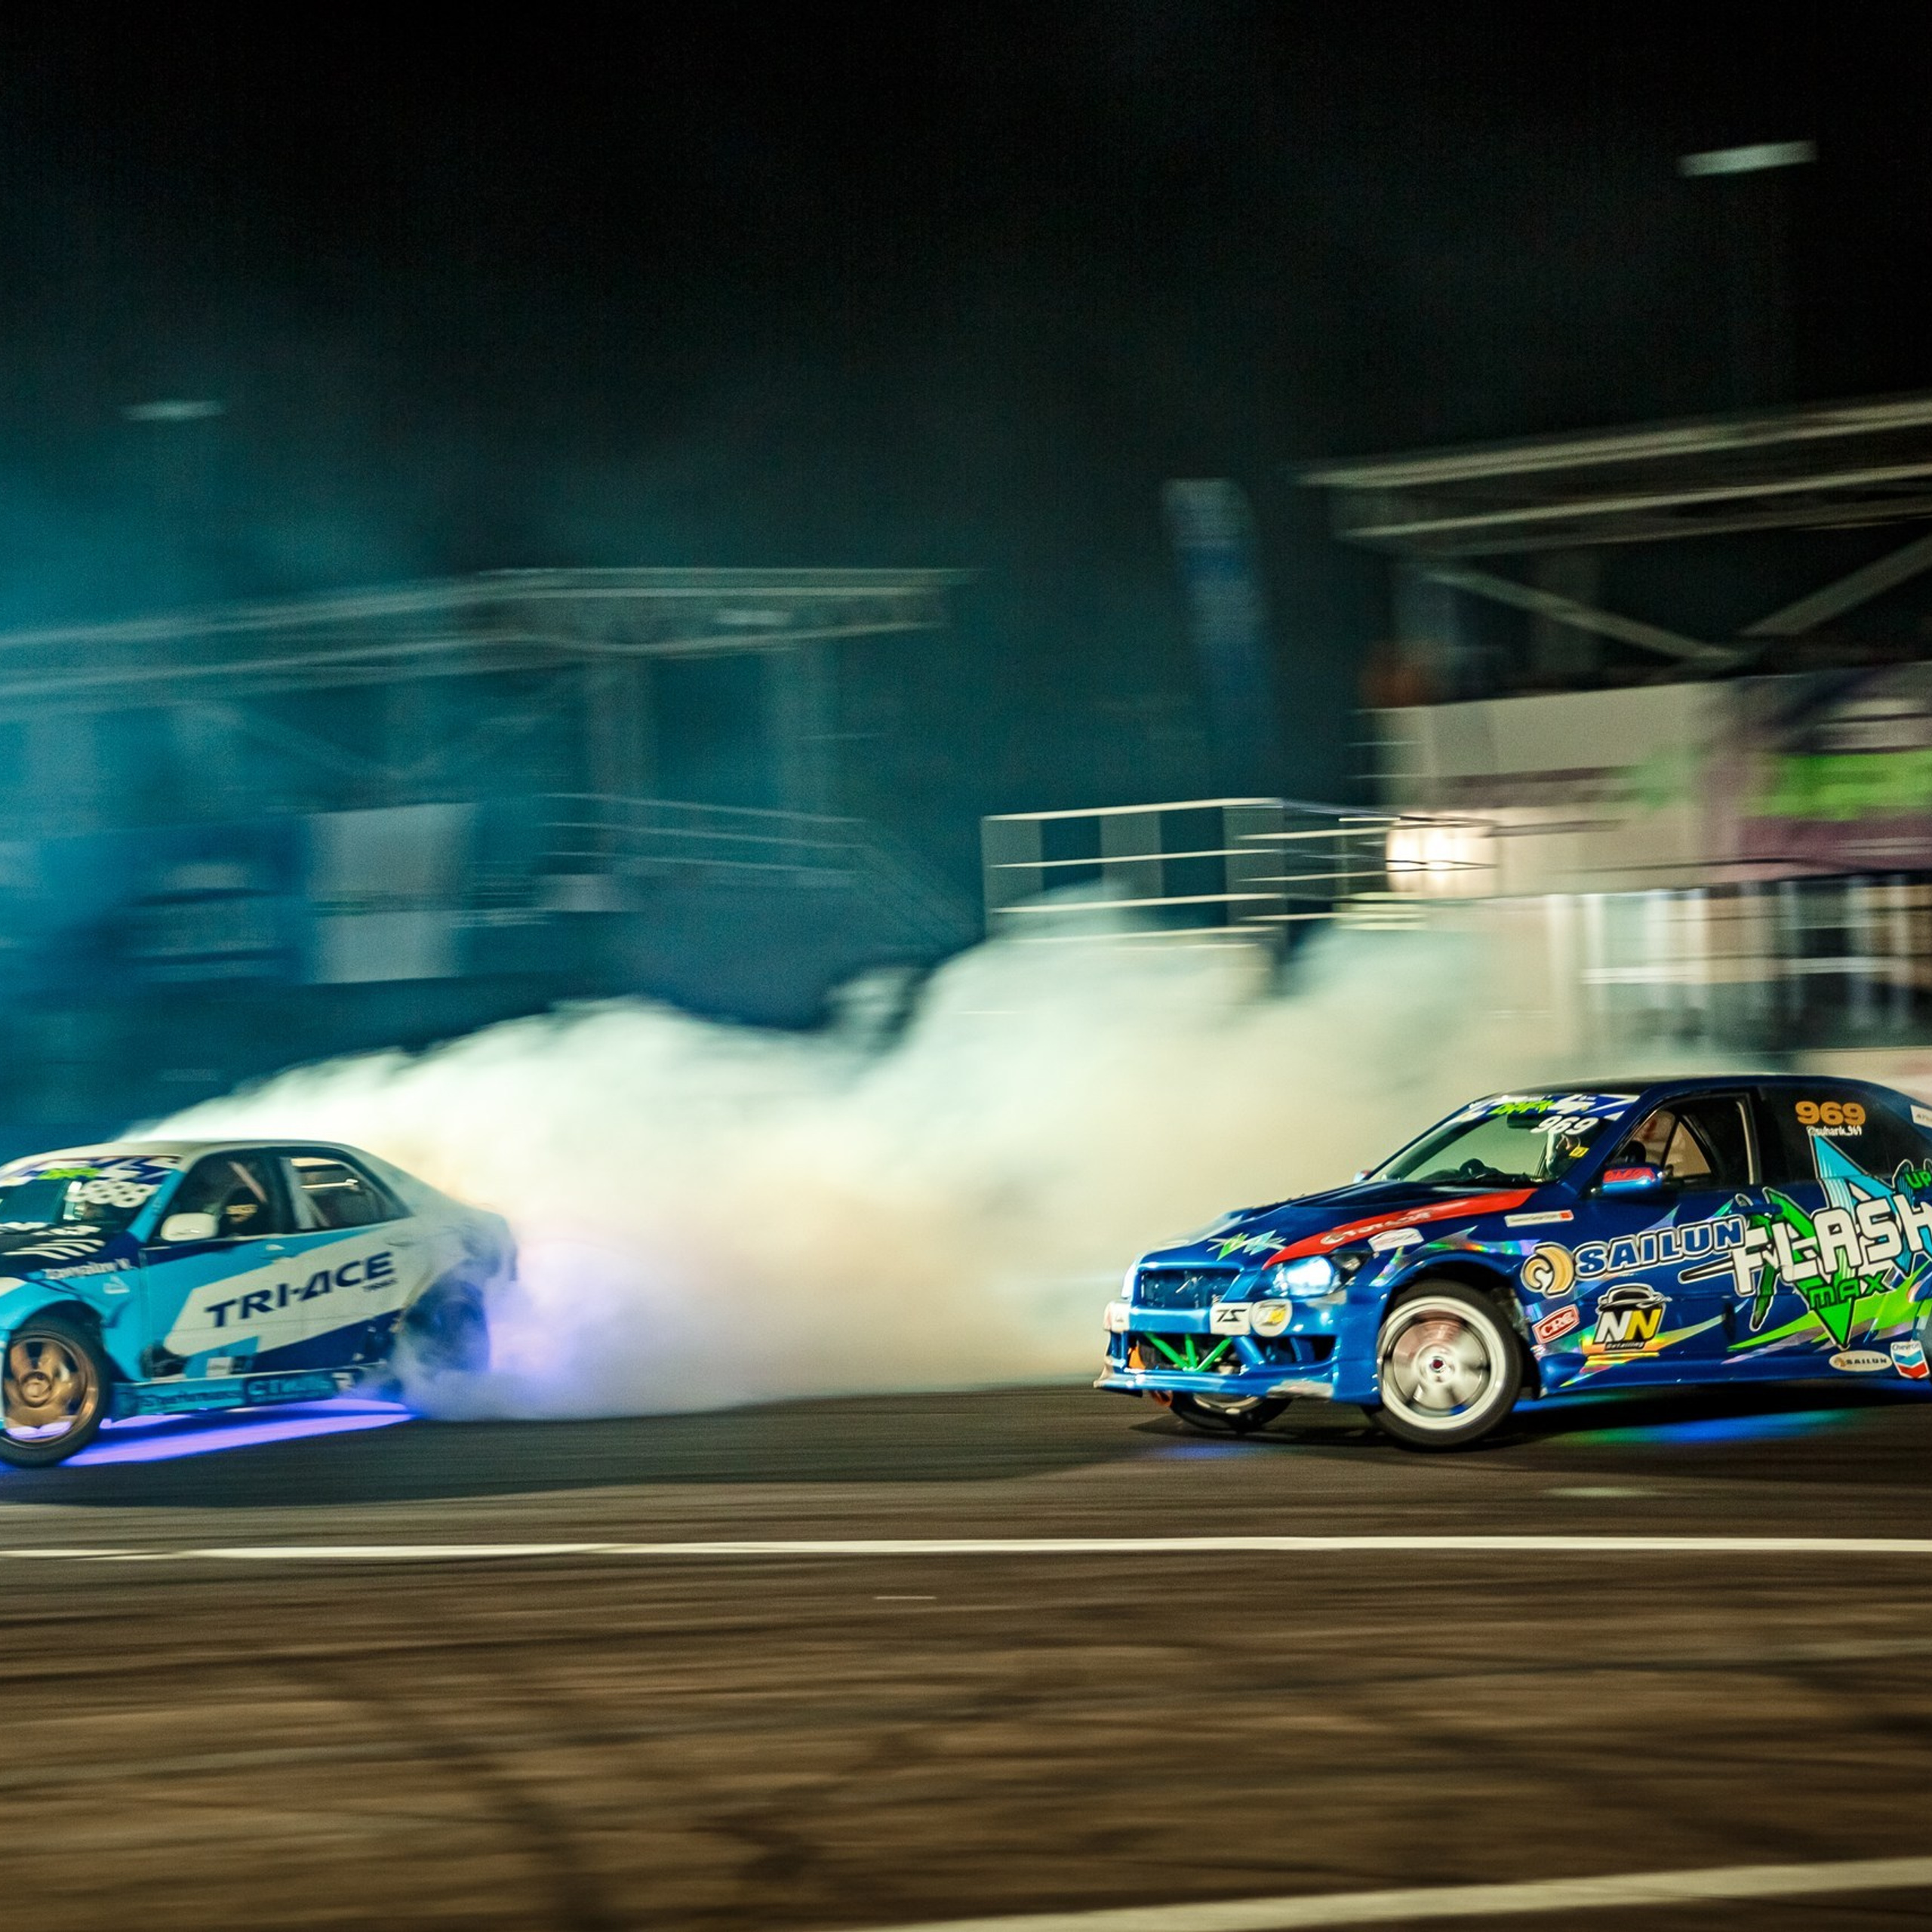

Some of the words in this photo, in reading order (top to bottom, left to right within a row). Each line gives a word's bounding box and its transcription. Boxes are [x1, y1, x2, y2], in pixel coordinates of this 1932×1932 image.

[1530, 1115, 1599, 1135] 969
[1795, 1100, 1866, 1126] 969
[1576, 1214, 1747, 1278] SAILUN
[1732, 1194, 1932, 1295] FLASH
[205, 1251, 395, 1328] TRI-ACE
[1595, 1309, 1662, 1344] NN
